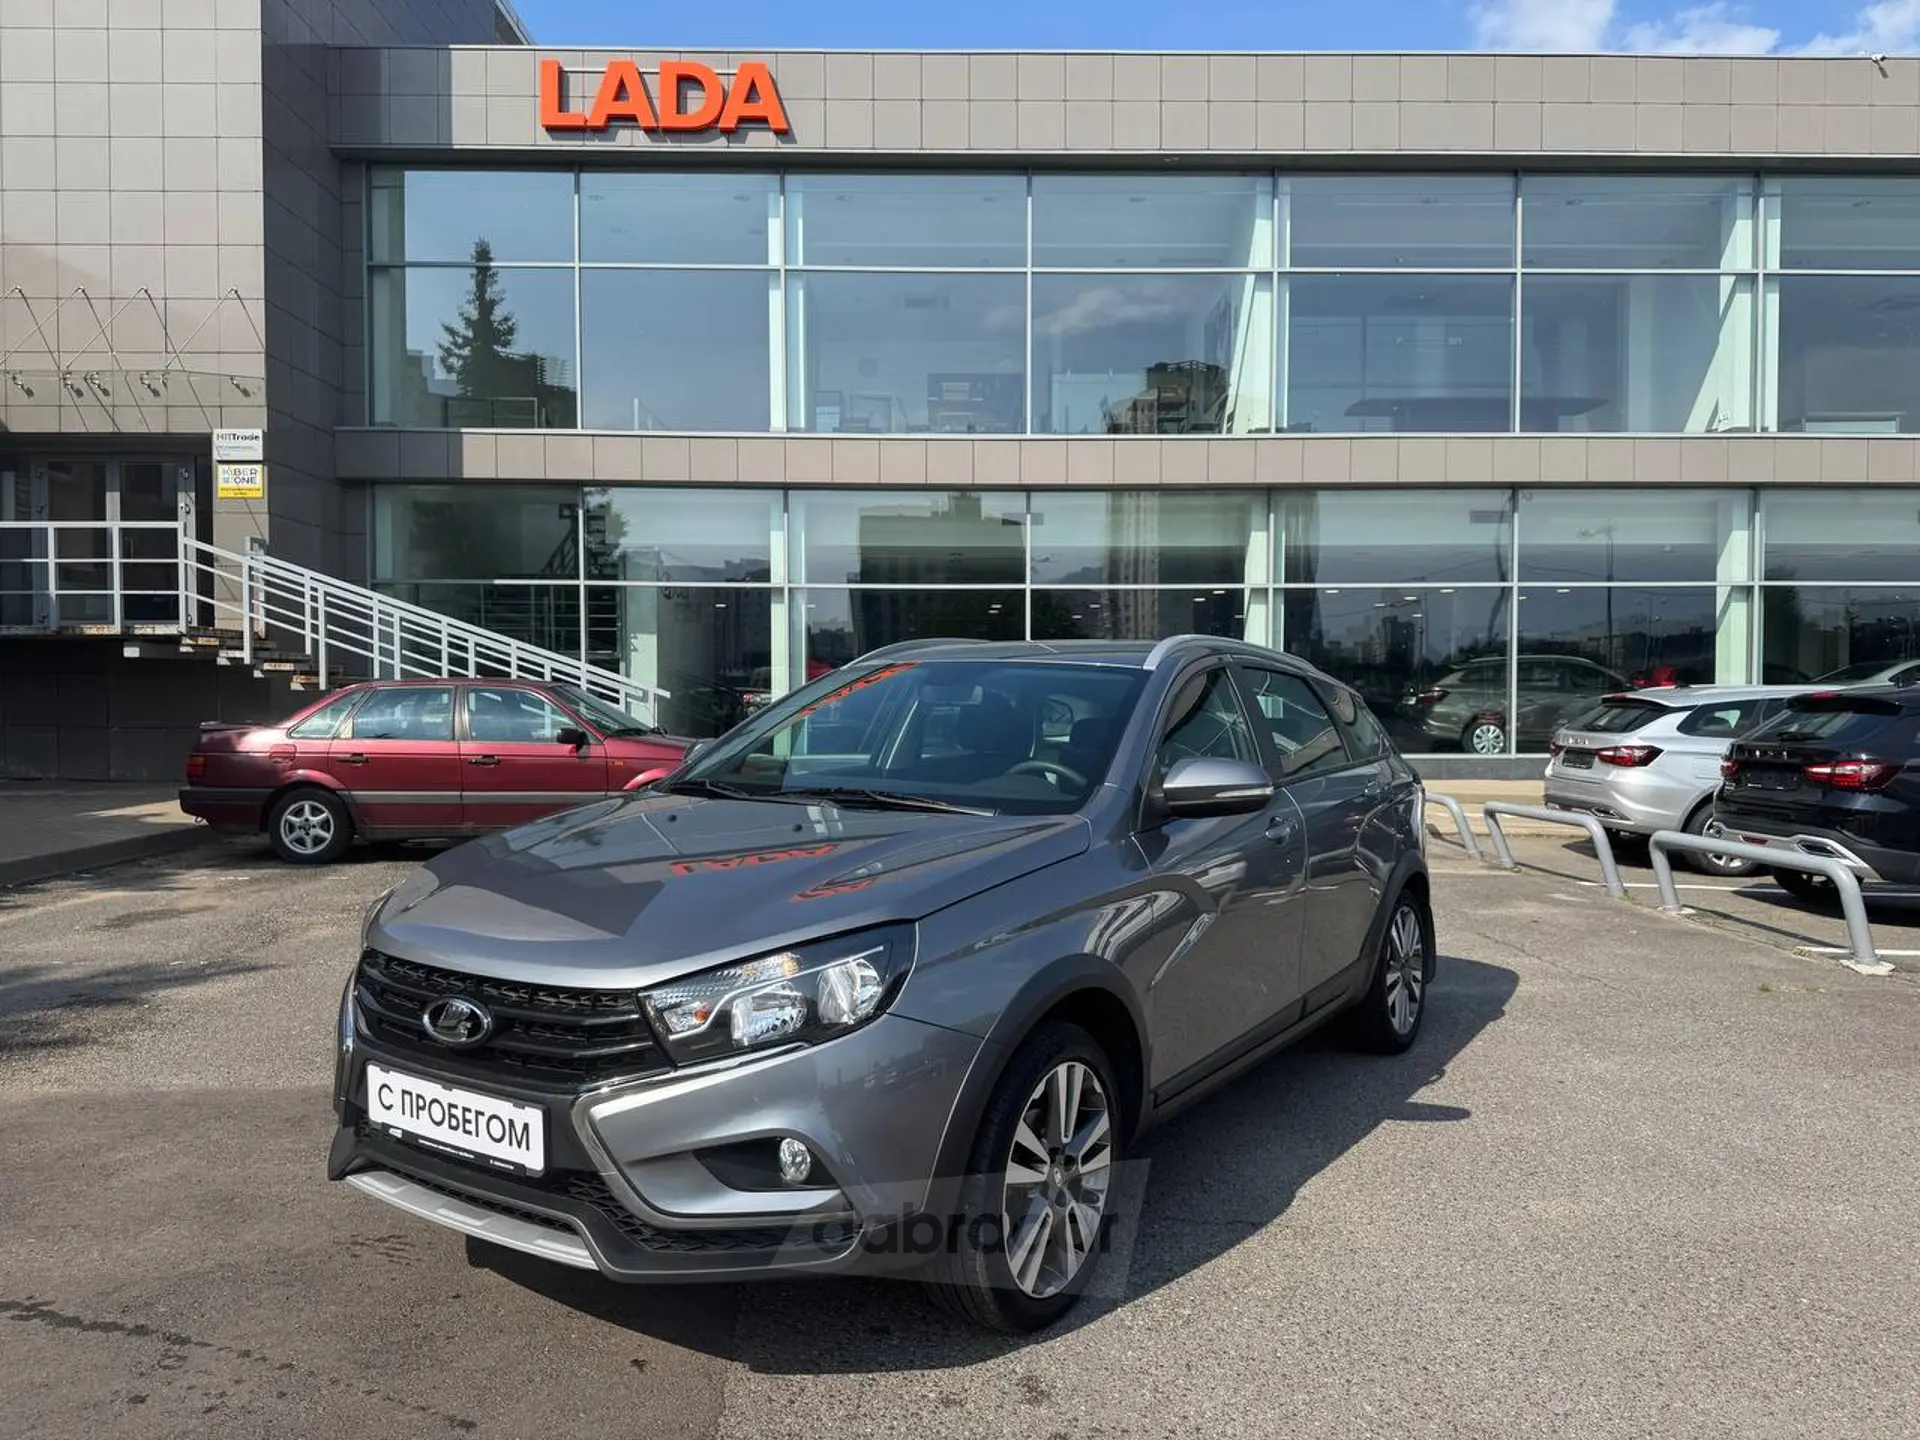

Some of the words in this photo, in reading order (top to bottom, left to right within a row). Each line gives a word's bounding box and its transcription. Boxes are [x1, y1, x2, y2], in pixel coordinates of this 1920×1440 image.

[541, 60, 789, 134] LADA
[378, 1083, 394, 1111] С
[401, 1089, 530, 1152] ПРОБЕГОМ
